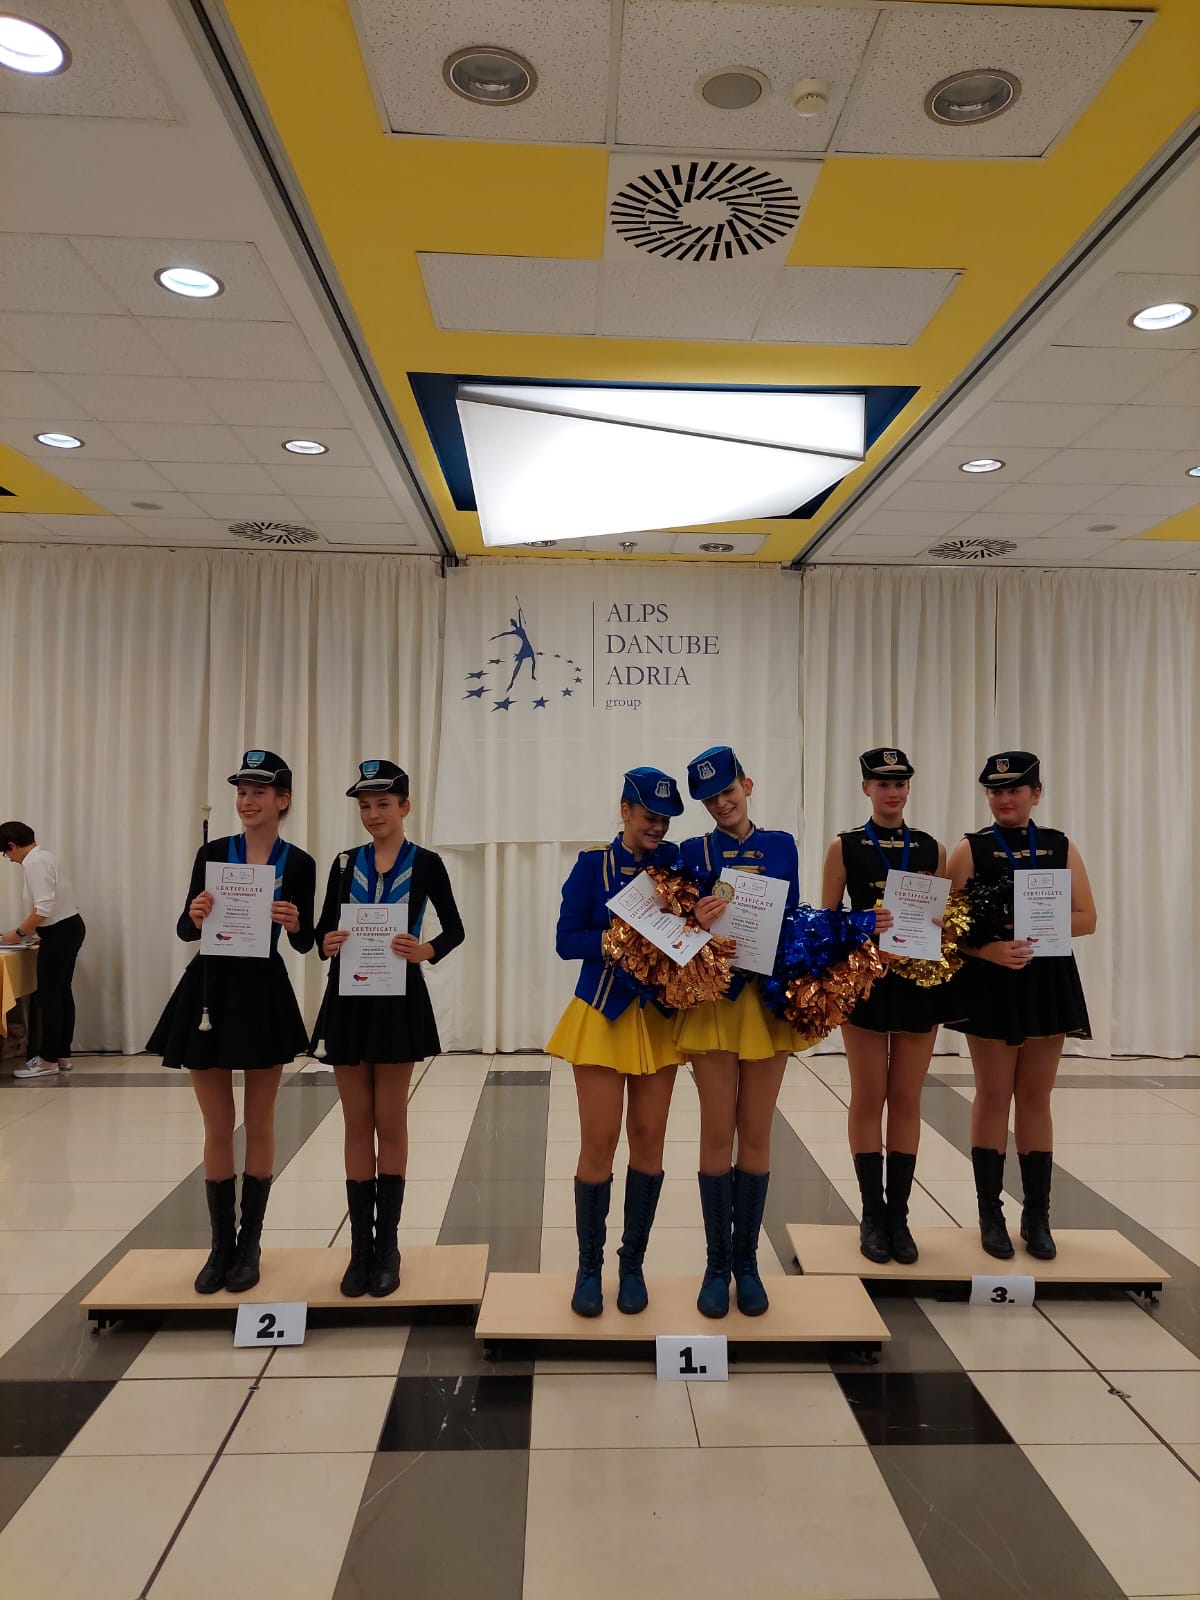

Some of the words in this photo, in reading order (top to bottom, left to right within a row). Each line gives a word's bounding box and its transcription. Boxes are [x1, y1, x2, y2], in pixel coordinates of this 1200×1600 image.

[607, 603, 669, 622] ALPS
[606, 634, 720, 654] DANUBE
[607, 666, 691, 685] ADRIA
[605, 699, 642, 710] group
[735, 895, 774, 908] RTIFICATE
[894, 891, 937, 901] CERTIFICATE
[990, 1287, 1015, 1303] 3.
[256, 1313, 285, 1338] 2.
[680, 1346, 707, 1374] 1.
